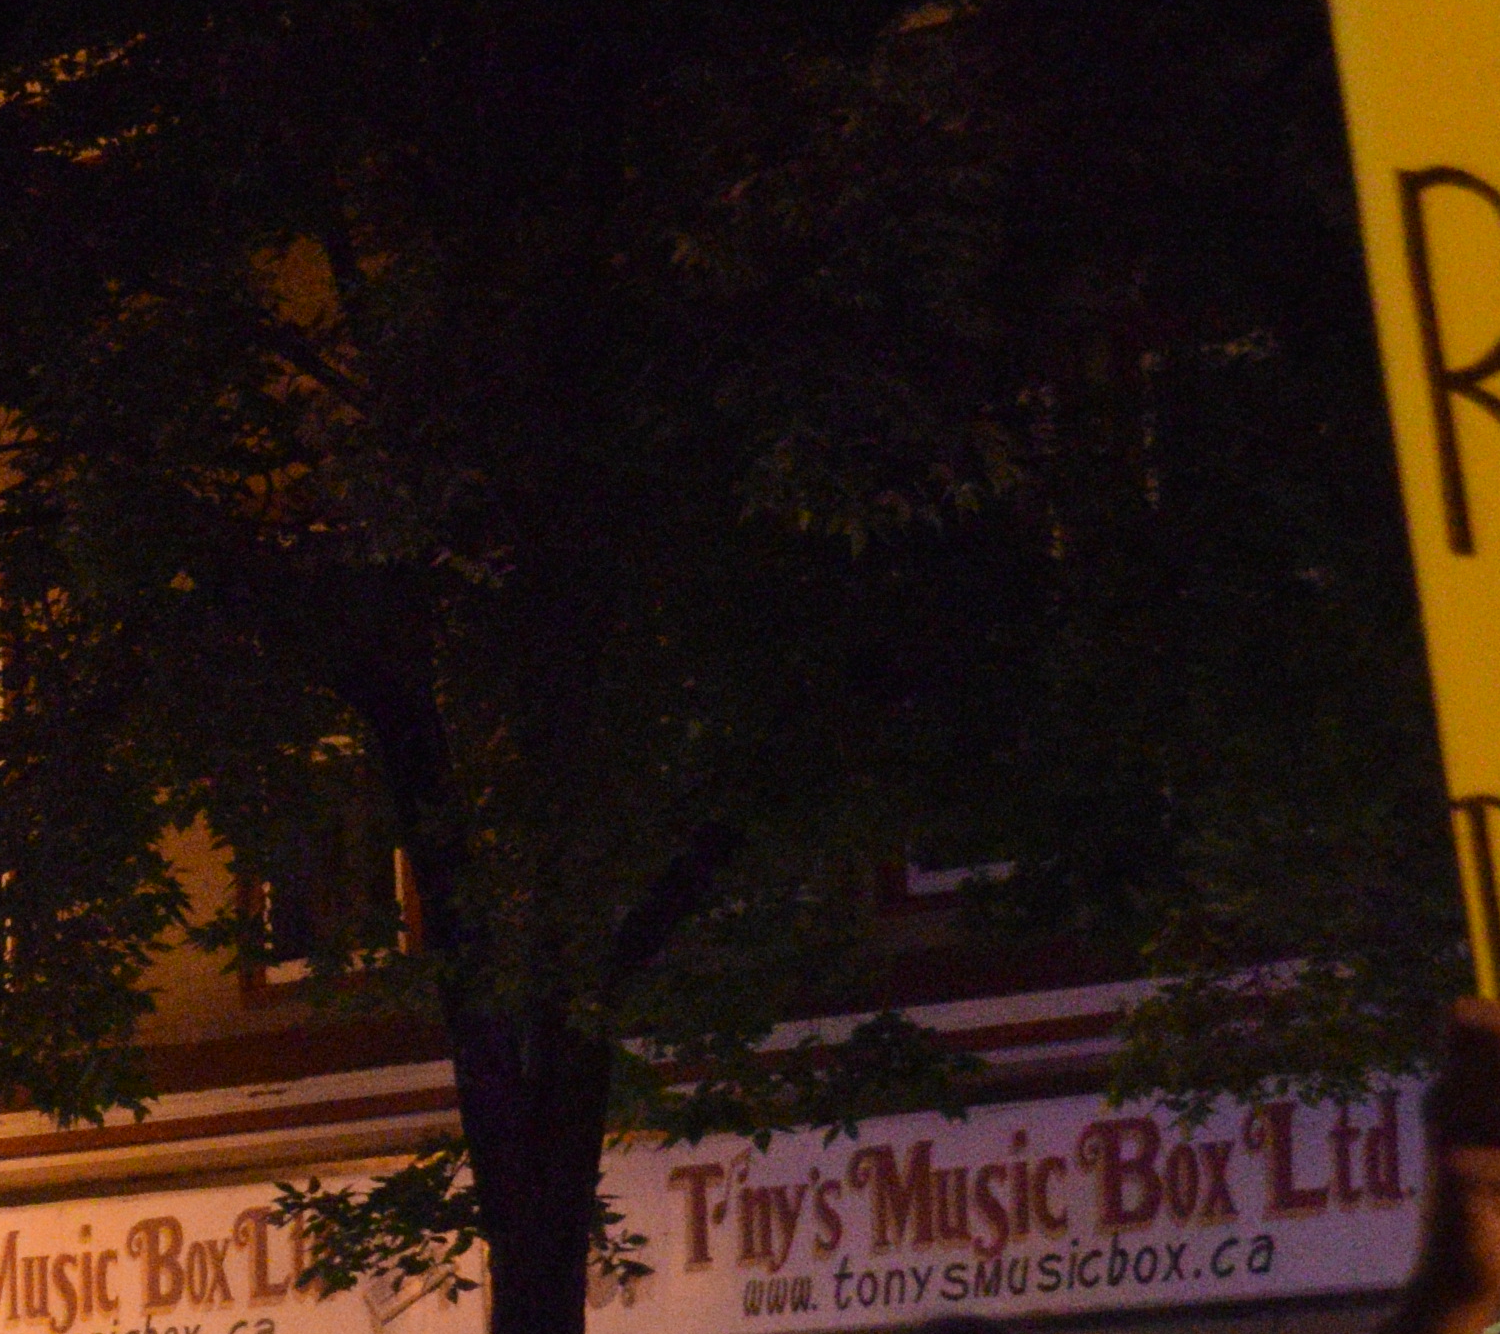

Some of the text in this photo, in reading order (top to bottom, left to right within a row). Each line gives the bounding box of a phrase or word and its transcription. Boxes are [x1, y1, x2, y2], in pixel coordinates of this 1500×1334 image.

[845, 1130, 1069, 1259] Music
[1077, 1117, 1238, 1232] Box
[127, 1216, 231, 1314] Box
